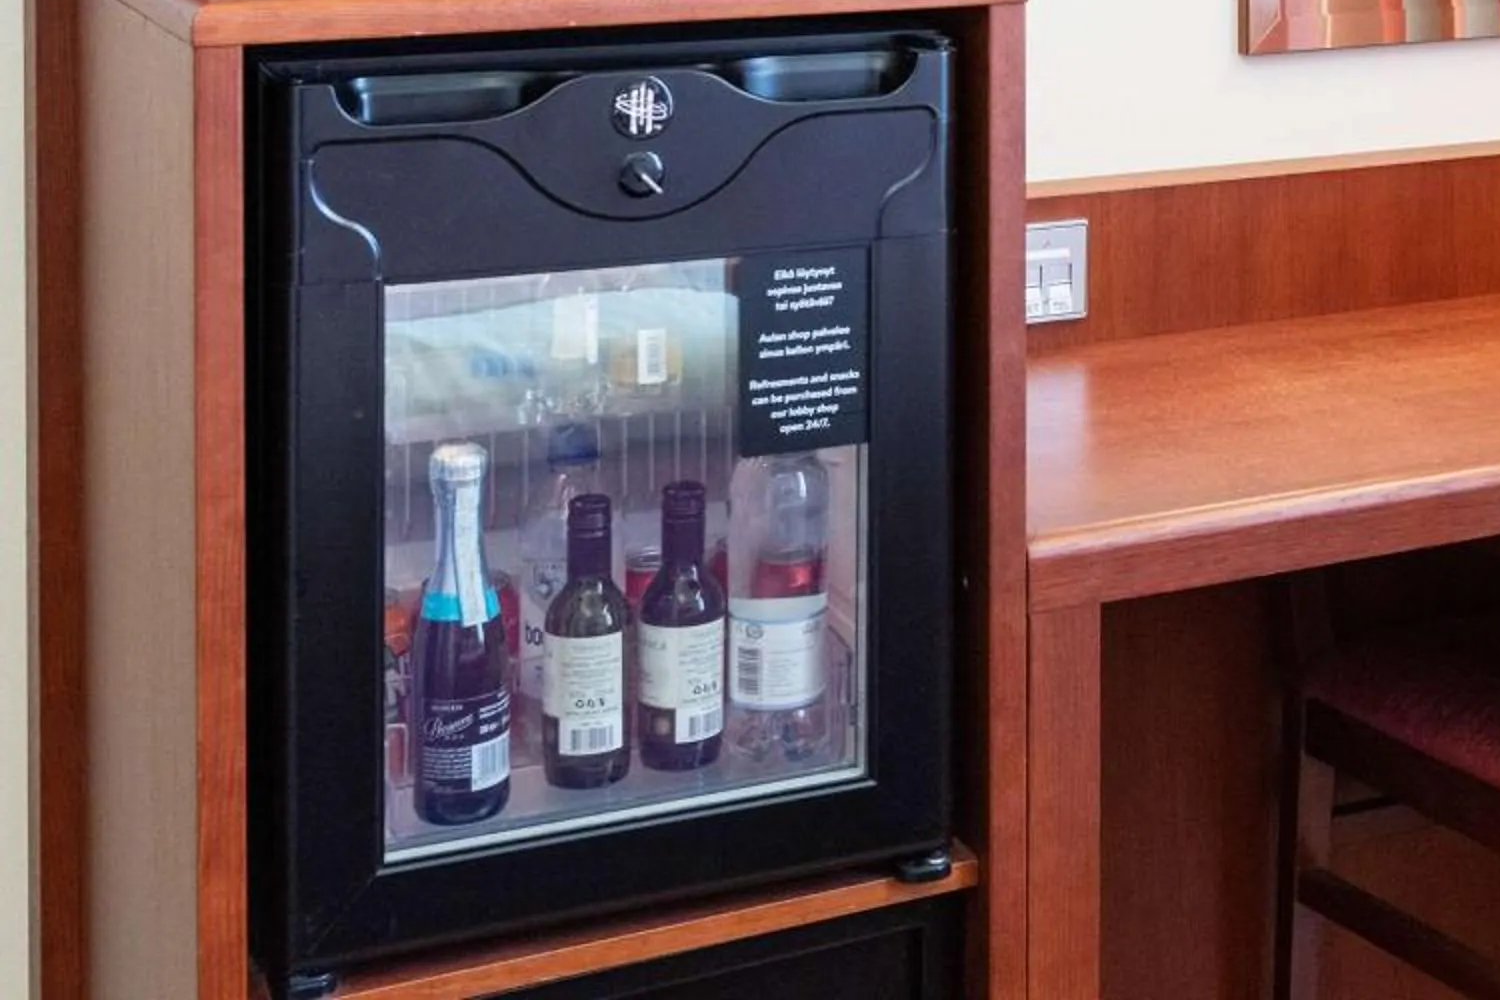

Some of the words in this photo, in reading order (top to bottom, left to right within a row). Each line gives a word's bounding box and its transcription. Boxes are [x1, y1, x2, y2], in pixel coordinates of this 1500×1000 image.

[787, 330, 811, 342] shop
[809, 372, 829, 385] and
[829, 369, 861, 382] snacks
[751, 397, 769, 406] can
[770, 393, 784, 404] be
[784, 387, 833, 405] purchased
[833, 385, 858, 397] from
[770, 409, 788, 419] our
[788, 405, 815, 418] lobby
[815, 403, 840, 415] shop
[779, 423, 804, 436] open
